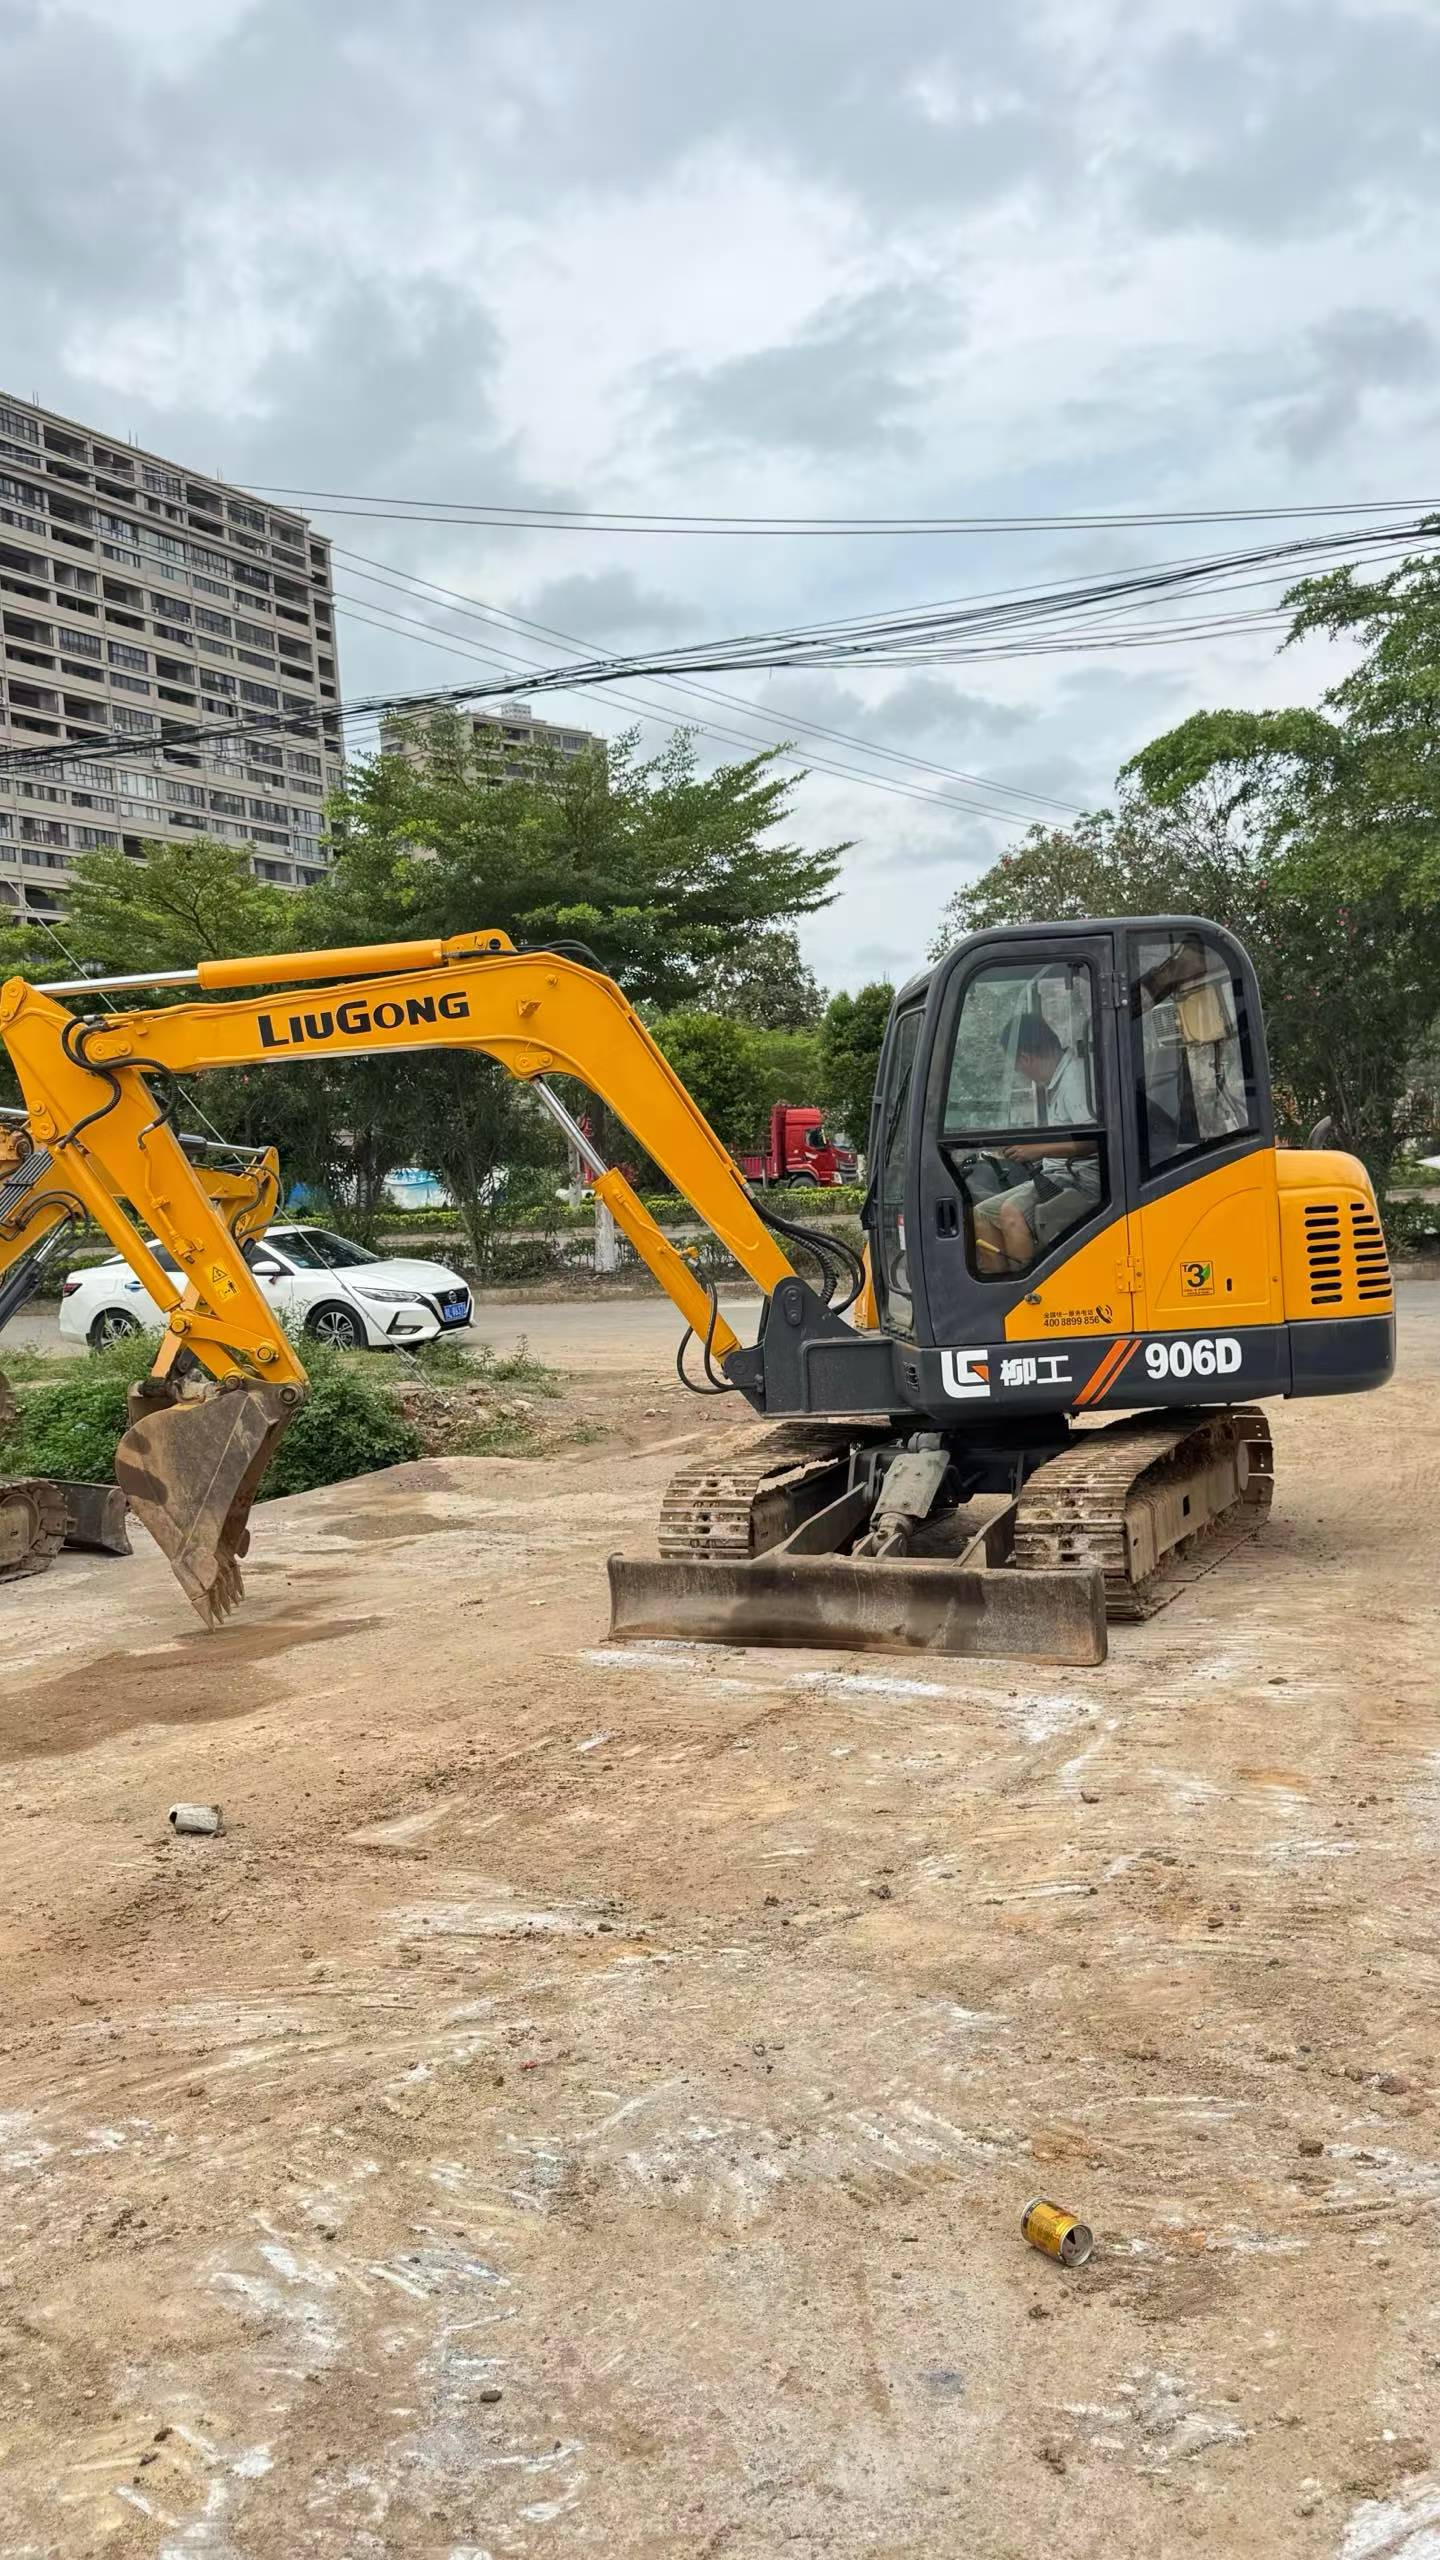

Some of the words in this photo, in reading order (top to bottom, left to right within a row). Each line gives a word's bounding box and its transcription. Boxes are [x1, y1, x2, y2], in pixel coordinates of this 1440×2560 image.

[1044, 1319, 1060, 1327] 400
[1061, 1317, 1082, 1326] 8899
[1000, 1355, 1072, 1387] 柳工
[1144, 1337, 1242, 1379] 906D
